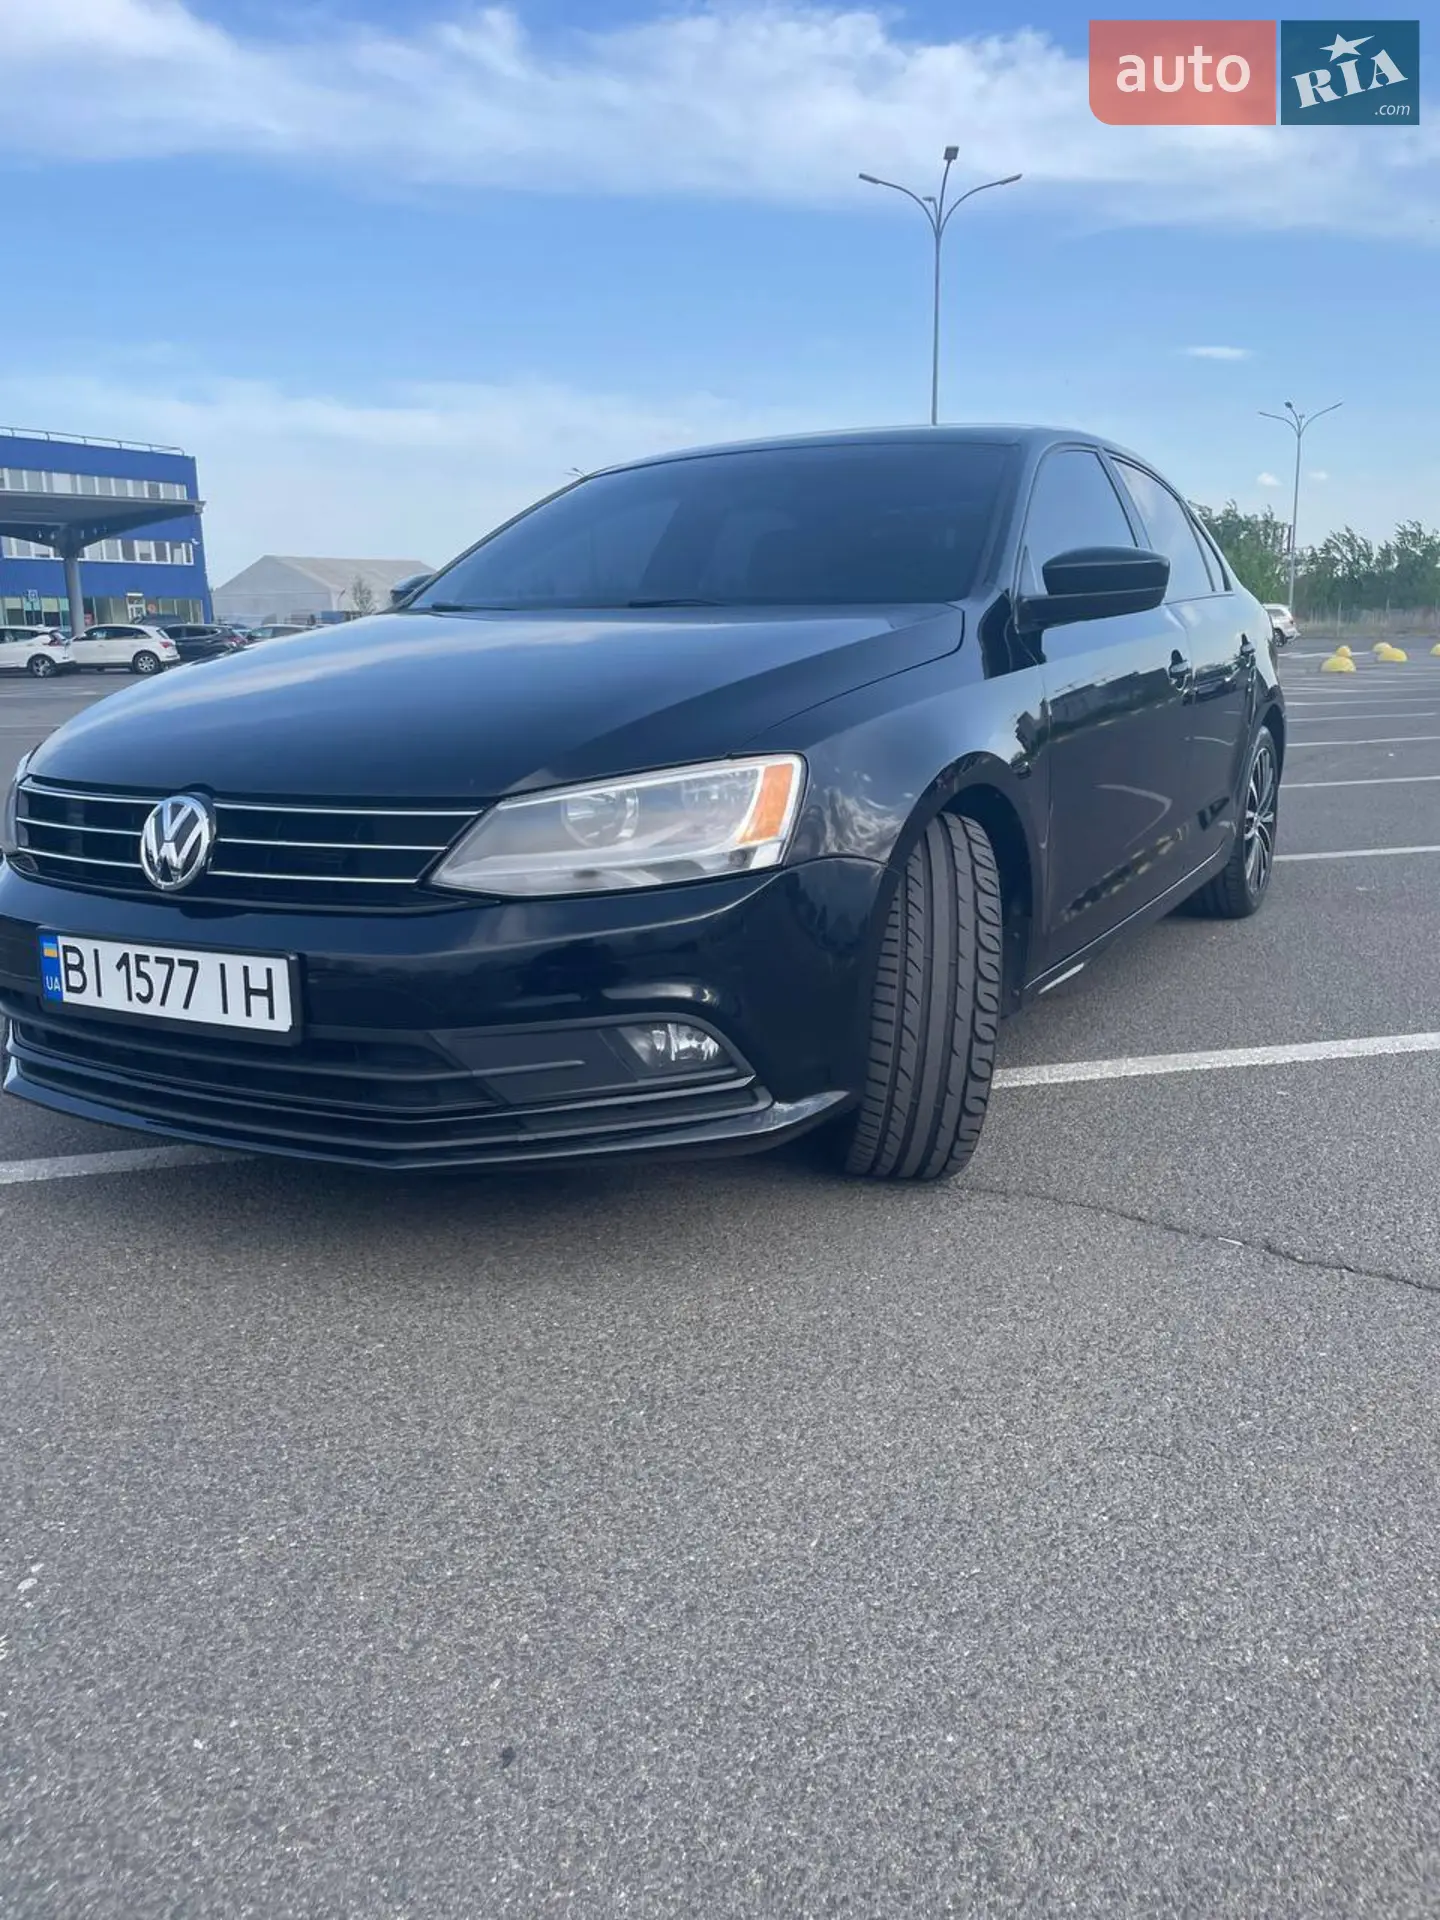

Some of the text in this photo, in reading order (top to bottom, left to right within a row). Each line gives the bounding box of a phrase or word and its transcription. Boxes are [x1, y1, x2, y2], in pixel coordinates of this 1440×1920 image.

[46, 976, 61, 991] UA
[62, 945, 275, 1020] BI 1577 IH
